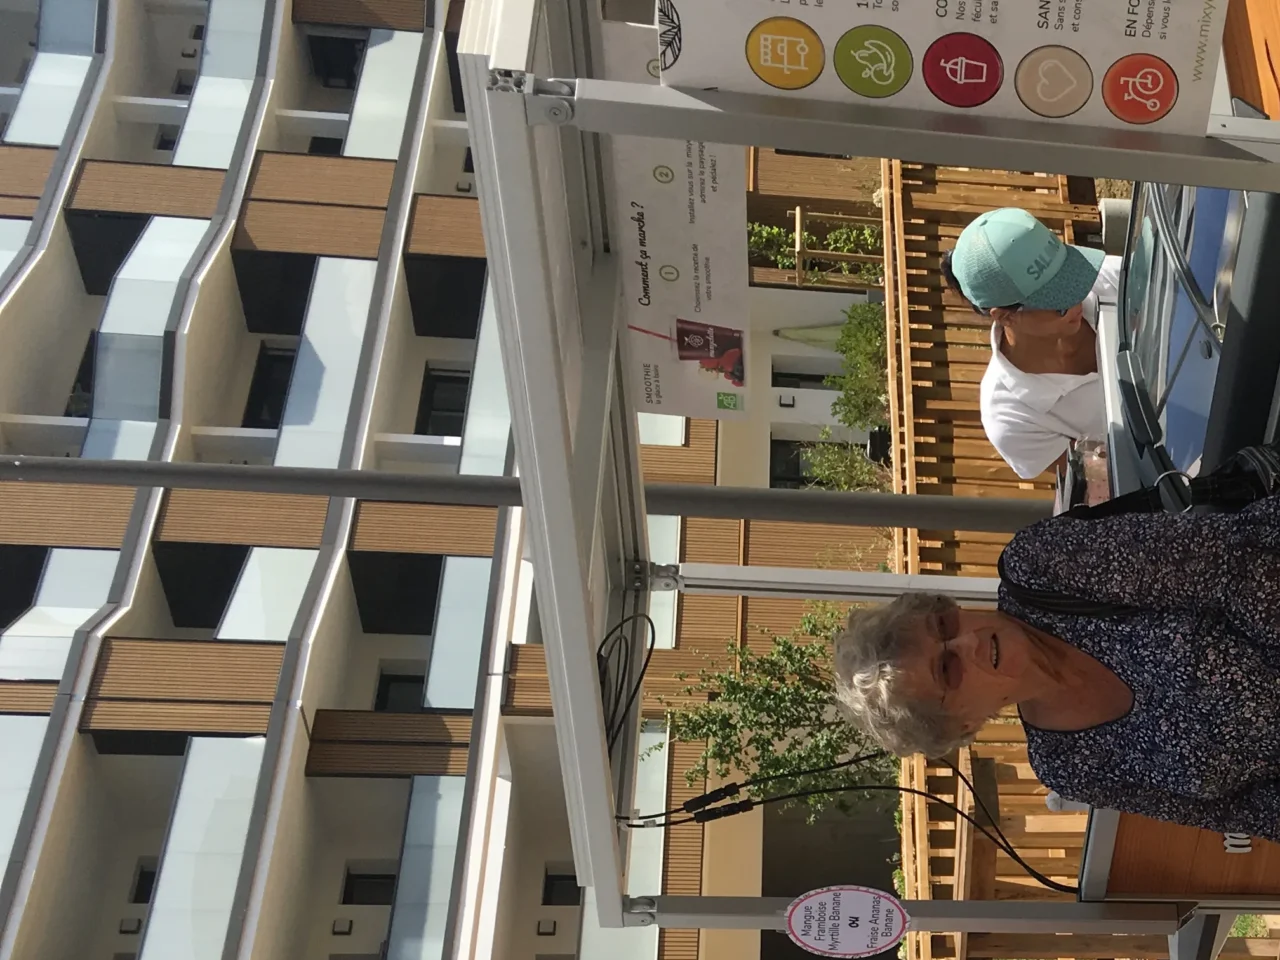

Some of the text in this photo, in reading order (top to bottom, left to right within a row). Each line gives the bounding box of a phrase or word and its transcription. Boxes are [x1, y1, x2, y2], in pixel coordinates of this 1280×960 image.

[935, 0, 948, 18] CO
[955, 0, 966, 20] Nos
[989, 14, 998, 24] et
[1036, 0, 1051, 30] SAN
[1054, 6, 1066, 30] Sans
[1161, 6, 1171, 29] vous
[1070, 22, 1080, 32] et
[1124, 19, 1138, 38] EN
[1158, 32, 1168, 40] si
[686, 168, 694, 179] sur
[698, 178, 706, 204] admirez
[688, 198, 696, 224] Installez
[630, 212, 647, 247] marche
[638, 250, 650, 260] ça
[691, 244, 698, 252] de
[704, 256, 712, 284] smoothie
[634, 261, 650, 306] Comment
[643, 363, 654, 404] SMOOTHIE
[801, 906, 814, 936] Mangue
[814, 902, 826, 941] Framboise
[828, 892, 842, 950] Myrtille Banane
[848, 916, 860, 928] ou
[866, 896, 880, 948] Fraise Ananas
[881, 908, 894, 938] Banane
